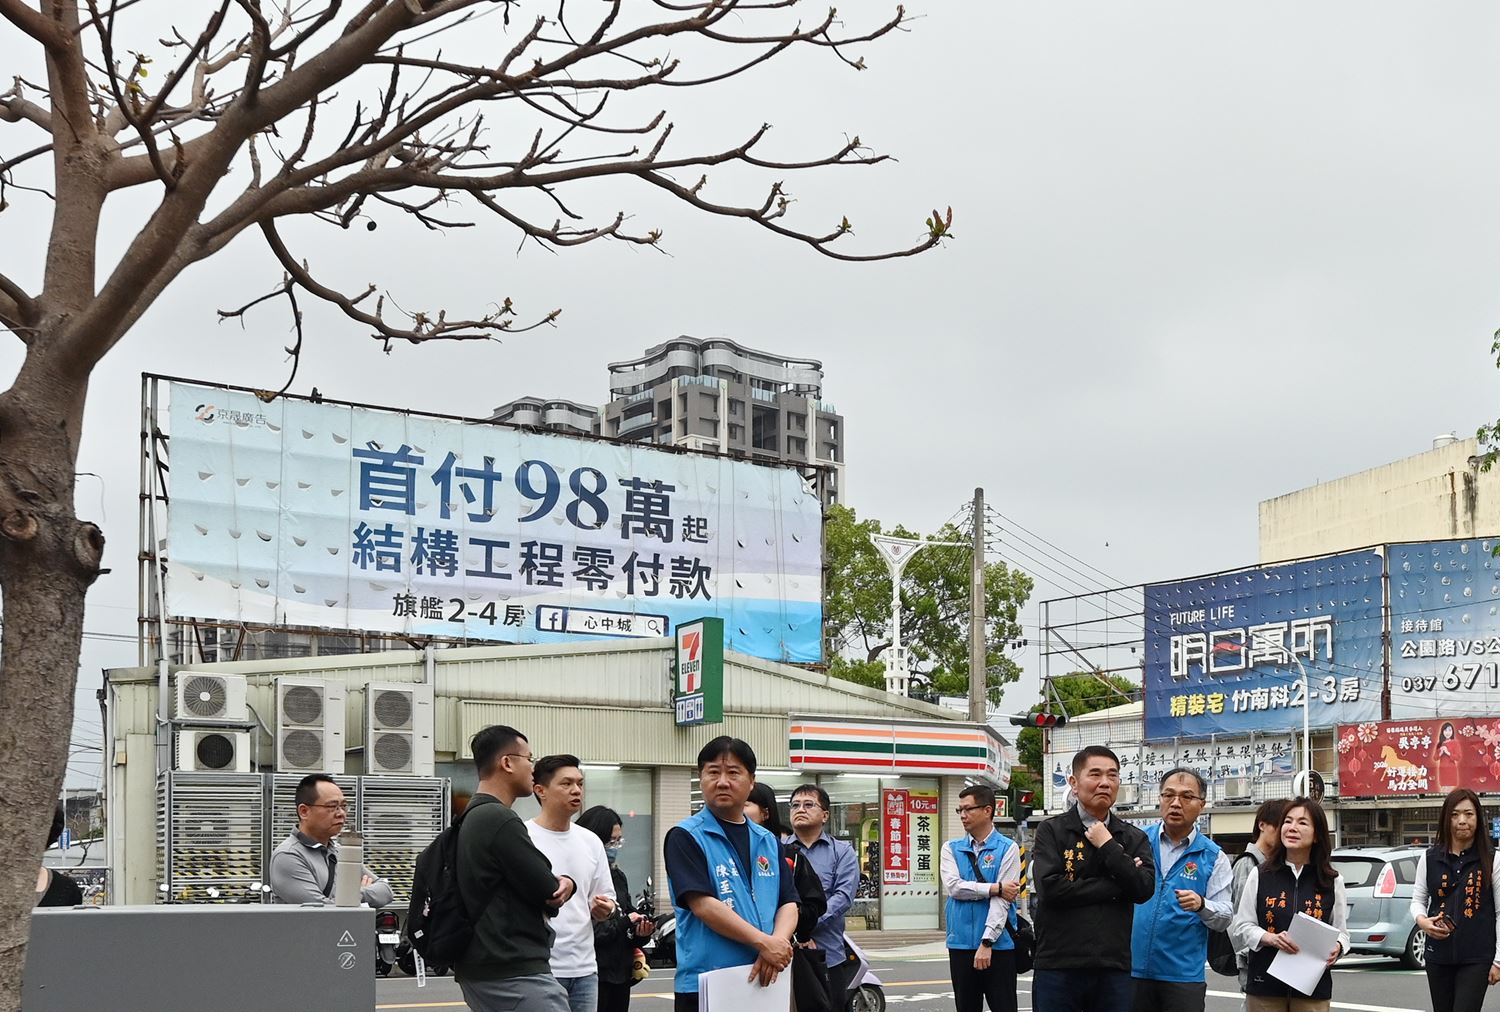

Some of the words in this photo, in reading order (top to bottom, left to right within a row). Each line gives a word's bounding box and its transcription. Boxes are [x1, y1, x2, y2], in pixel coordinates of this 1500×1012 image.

[352, 440, 709, 544] 首付98萬起
[352, 521, 712, 601] 結構工程零付款
[392, 593, 526, 628] 旗艦2-4房
[584, 615, 632, 633] 心中城
[1170, 609, 1206, 626] FUTURE
[1210, 604, 1235, 621] LIFE
[1400, 618, 1443, 634] 接待館
[1232, 676, 1361, 713] 竹南科2-3房
[1402, 676, 1437, 692] 037
[1170, 692, 1225, 717] 精裝宅
[917, 815, 931, 871] 茶葉蛋
